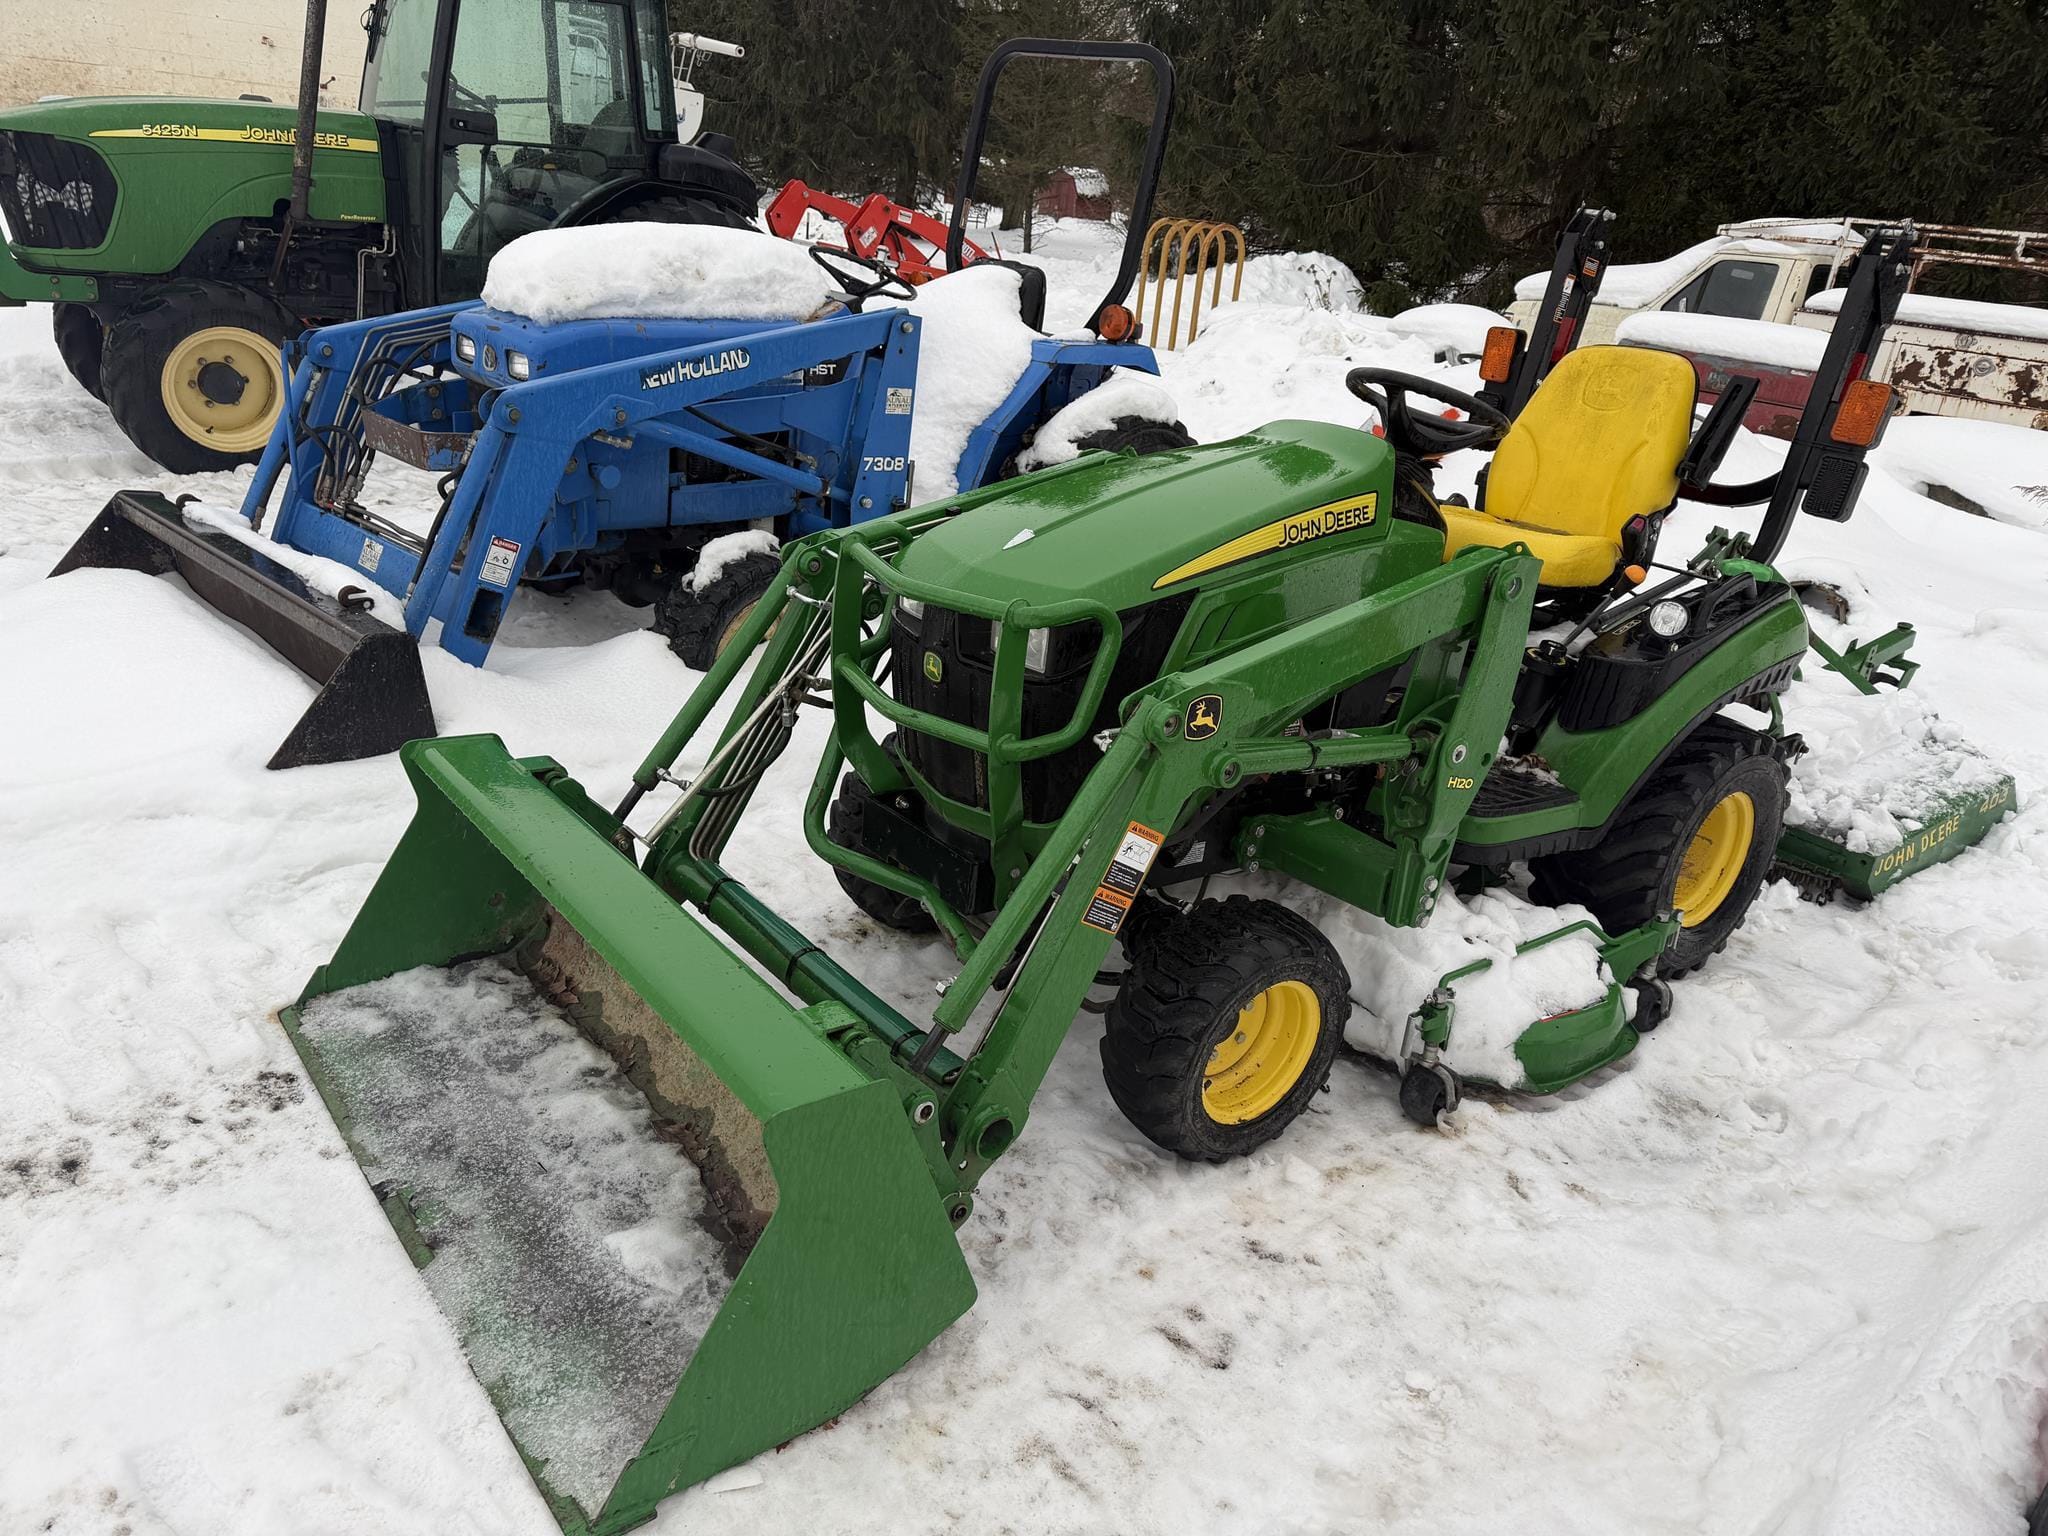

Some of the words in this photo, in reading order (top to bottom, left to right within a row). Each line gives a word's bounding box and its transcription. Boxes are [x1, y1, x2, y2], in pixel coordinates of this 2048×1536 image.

[142, 124, 198, 137] 5425N
[240, 125, 290, 142] JOHN
[677, 348, 751, 381] HOLLAND
[809, 364, 837, 376] HST
[864, 457, 904, 471] 7308
[1279, 517, 1321, 546] JOHN
[1324, 505, 1370, 532] DEERE
[1447, 776, 1474, 789] H120
[1874, 843, 1915, 877] JOHN
[1921, 815, 1961, 853] DEERE
